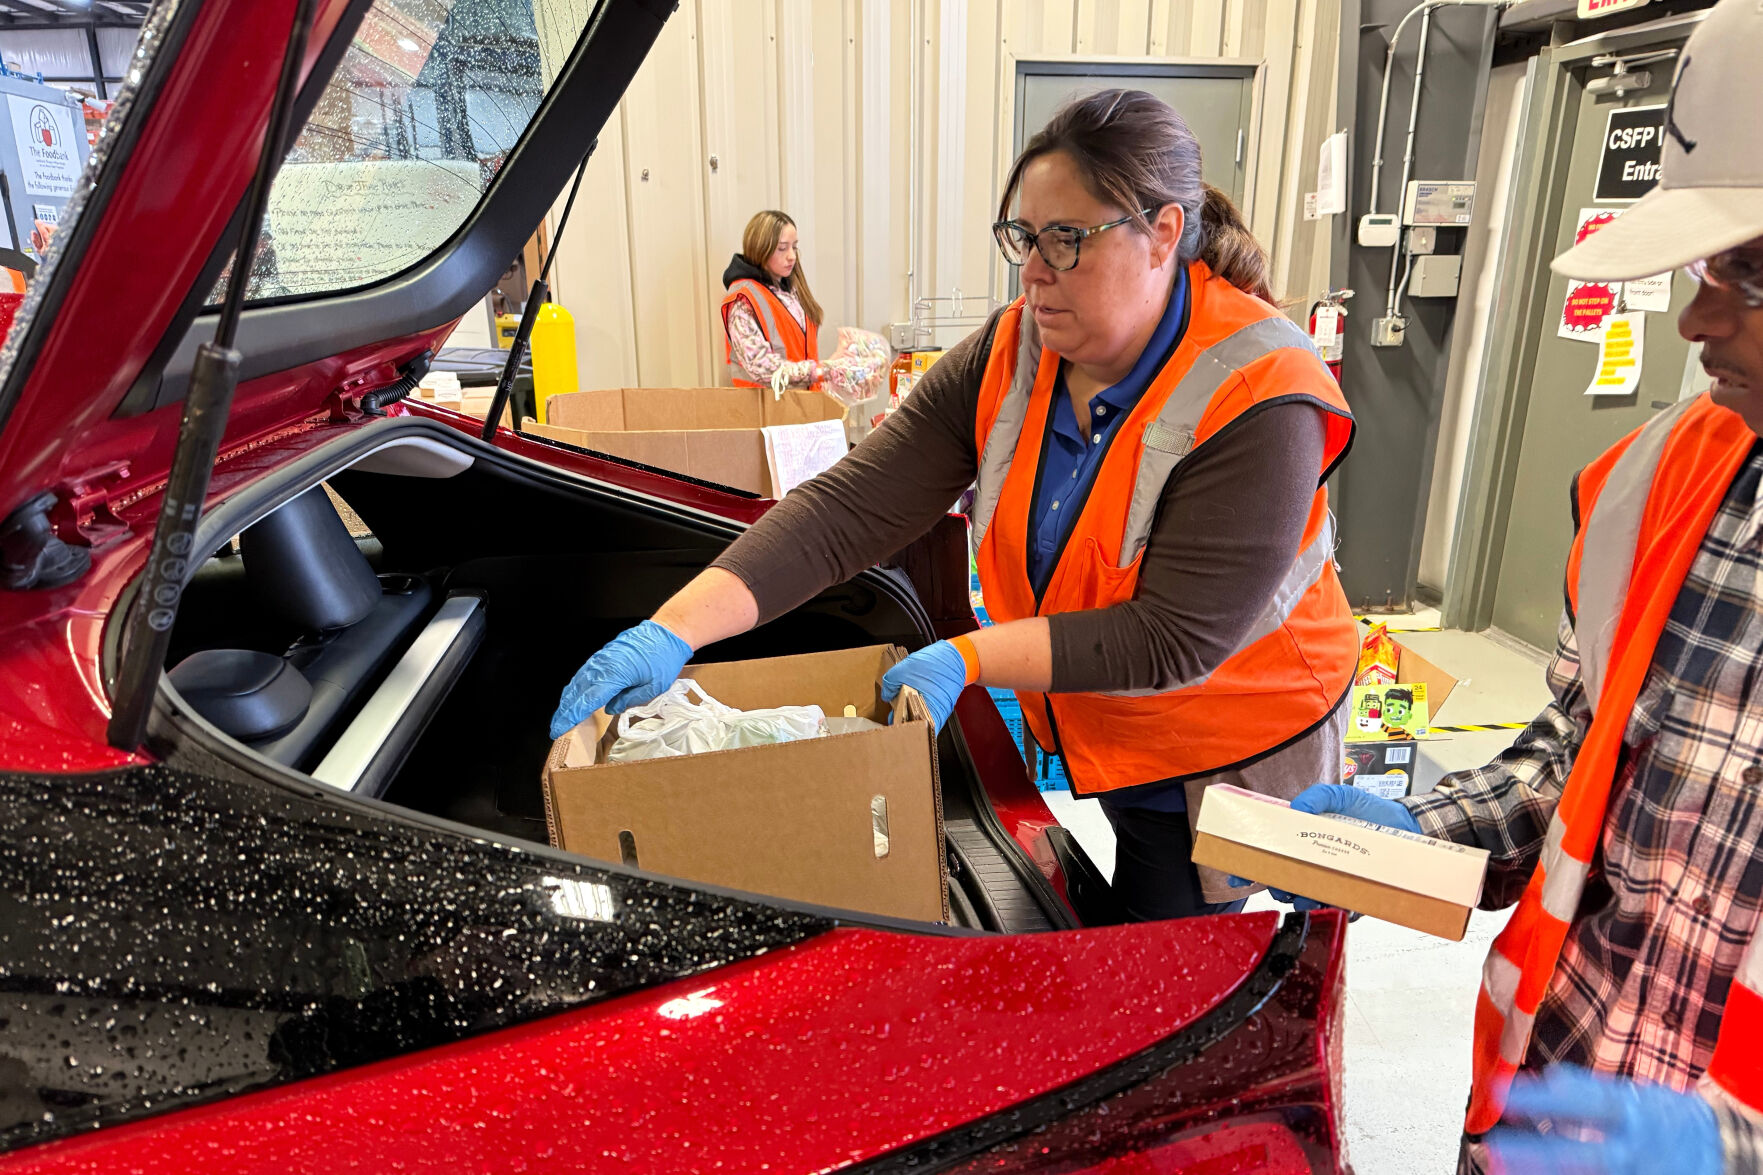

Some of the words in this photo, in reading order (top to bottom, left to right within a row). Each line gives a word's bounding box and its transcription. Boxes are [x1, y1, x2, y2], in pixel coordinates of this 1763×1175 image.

[1608, 126, 1656, 150] CSFP
[29, 146, 41, 157] The
[1621, 160, 1664, 181] Entra
[1571, 298, 1579, 306] DO
[1589, 297, 1600, 305] STEP
[1600, 297, 1609, 305] ON
[1582, 308, 1603, 316] PALLETS
[1300, 831, 1370, 855] BONGARDS
